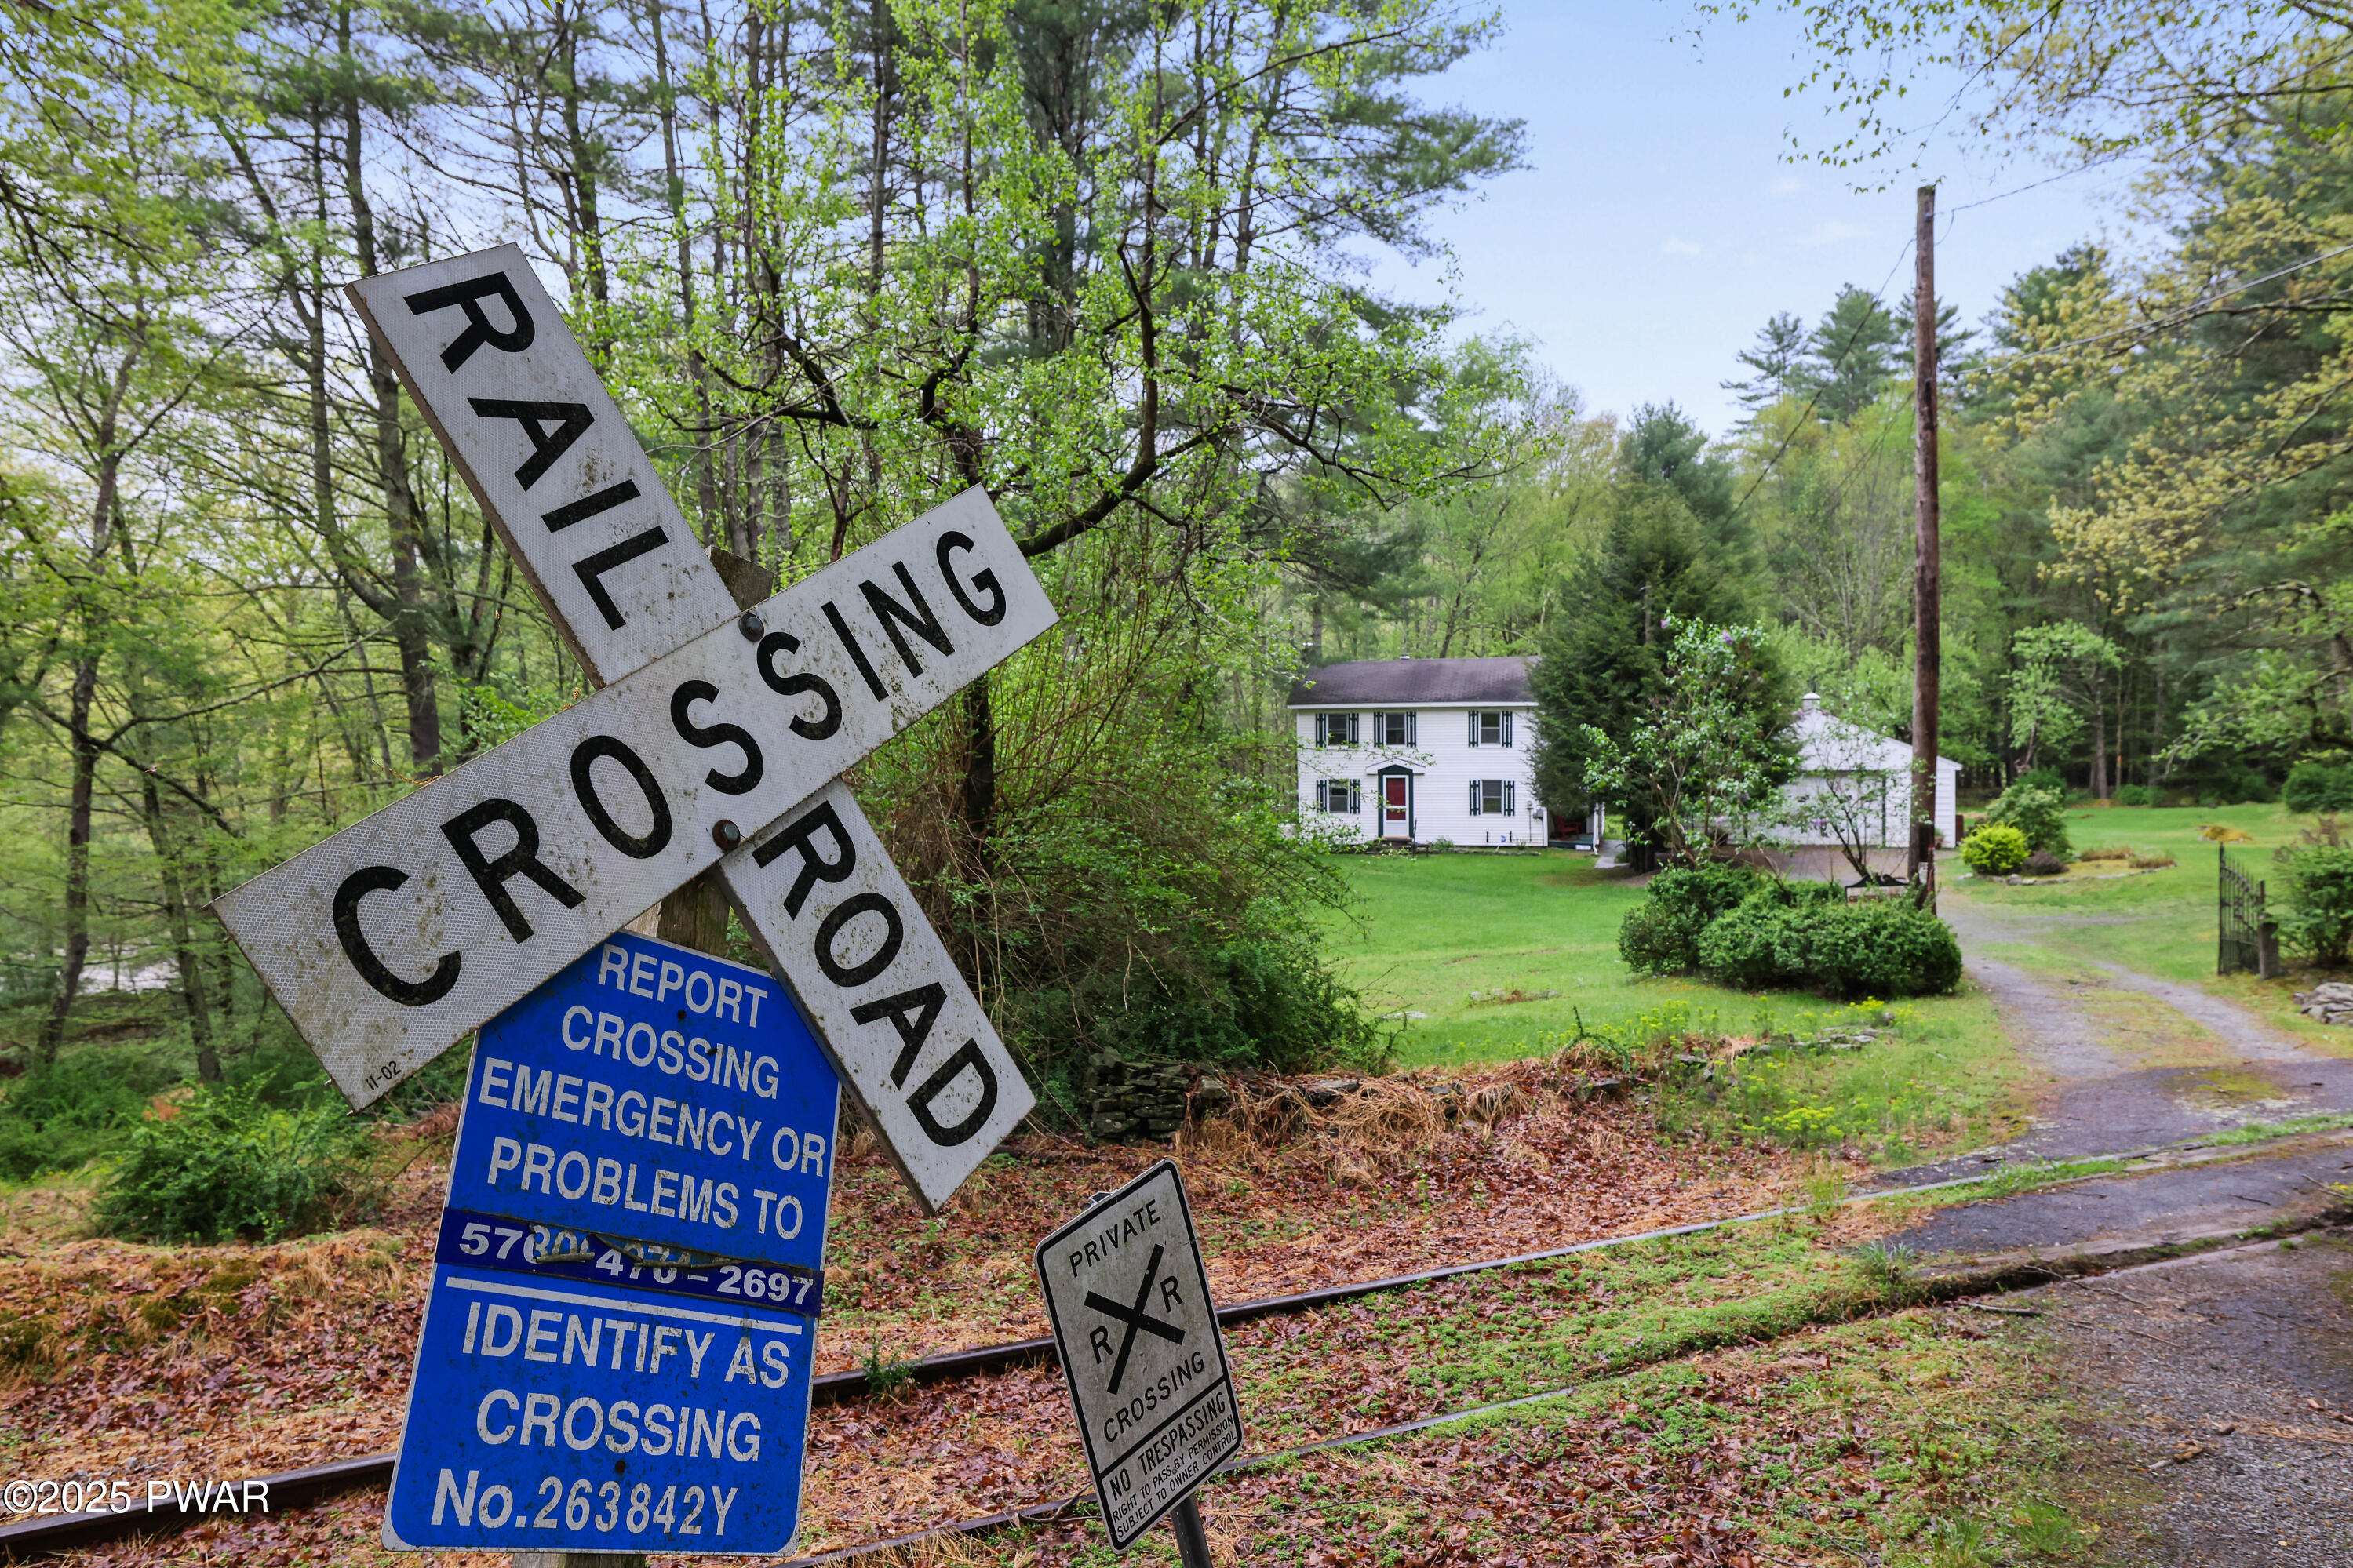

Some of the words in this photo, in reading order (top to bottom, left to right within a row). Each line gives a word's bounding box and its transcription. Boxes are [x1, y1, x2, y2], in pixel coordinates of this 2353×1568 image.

[403, 271, 670, 631] RAIL
[333, 531, 1007, 1006] CROSSING
[598, 943, 768, 1028] REPORT
[751, 800, 998, 1147] ROAD
[561, 1005, 780, 1100] CROSSING
[479, 1057, 762, 1162] EMERGENCY
[771, 1127, 826, 1177] OR
[487, 1137, 739, 1229] PROBLEMS
[753, 1189, 803, 1240] TO
[1069, 1199, 1161, 1278] PRIVATE
[1160, 1275, 1183, 1313] R
[462, 1301, 715, 1378] IDENTIFY
[724, 1337, 790, 1388] AS
[1089, 1326, 1114, 1365] R
[476, 1389, 761, 1462] CROSSING
[1104, 1351, 1204, 1443] CROSSING
[1109, 1468, 1131, 1501] NO
[1138, 1392, 1226, 1475] TRESPASSING
[1112, 1493, 1138, 1524] RIGHT
[1140, 1483, 1150, 1499] TO
[1152, 1464, 1172, 1489] PASS
[1174, 1453, 1186, 1470] BY
[1187, 1414, 1234, 1460] PERMISSION
[1116, 1498, 1154, 1538] SUBJECT
[1156, 1487, 1167, 1504] TO
[1169, 1461, 1200, 1492] OWNER
[1202, 1430, 1237, 1465] CONTROL
